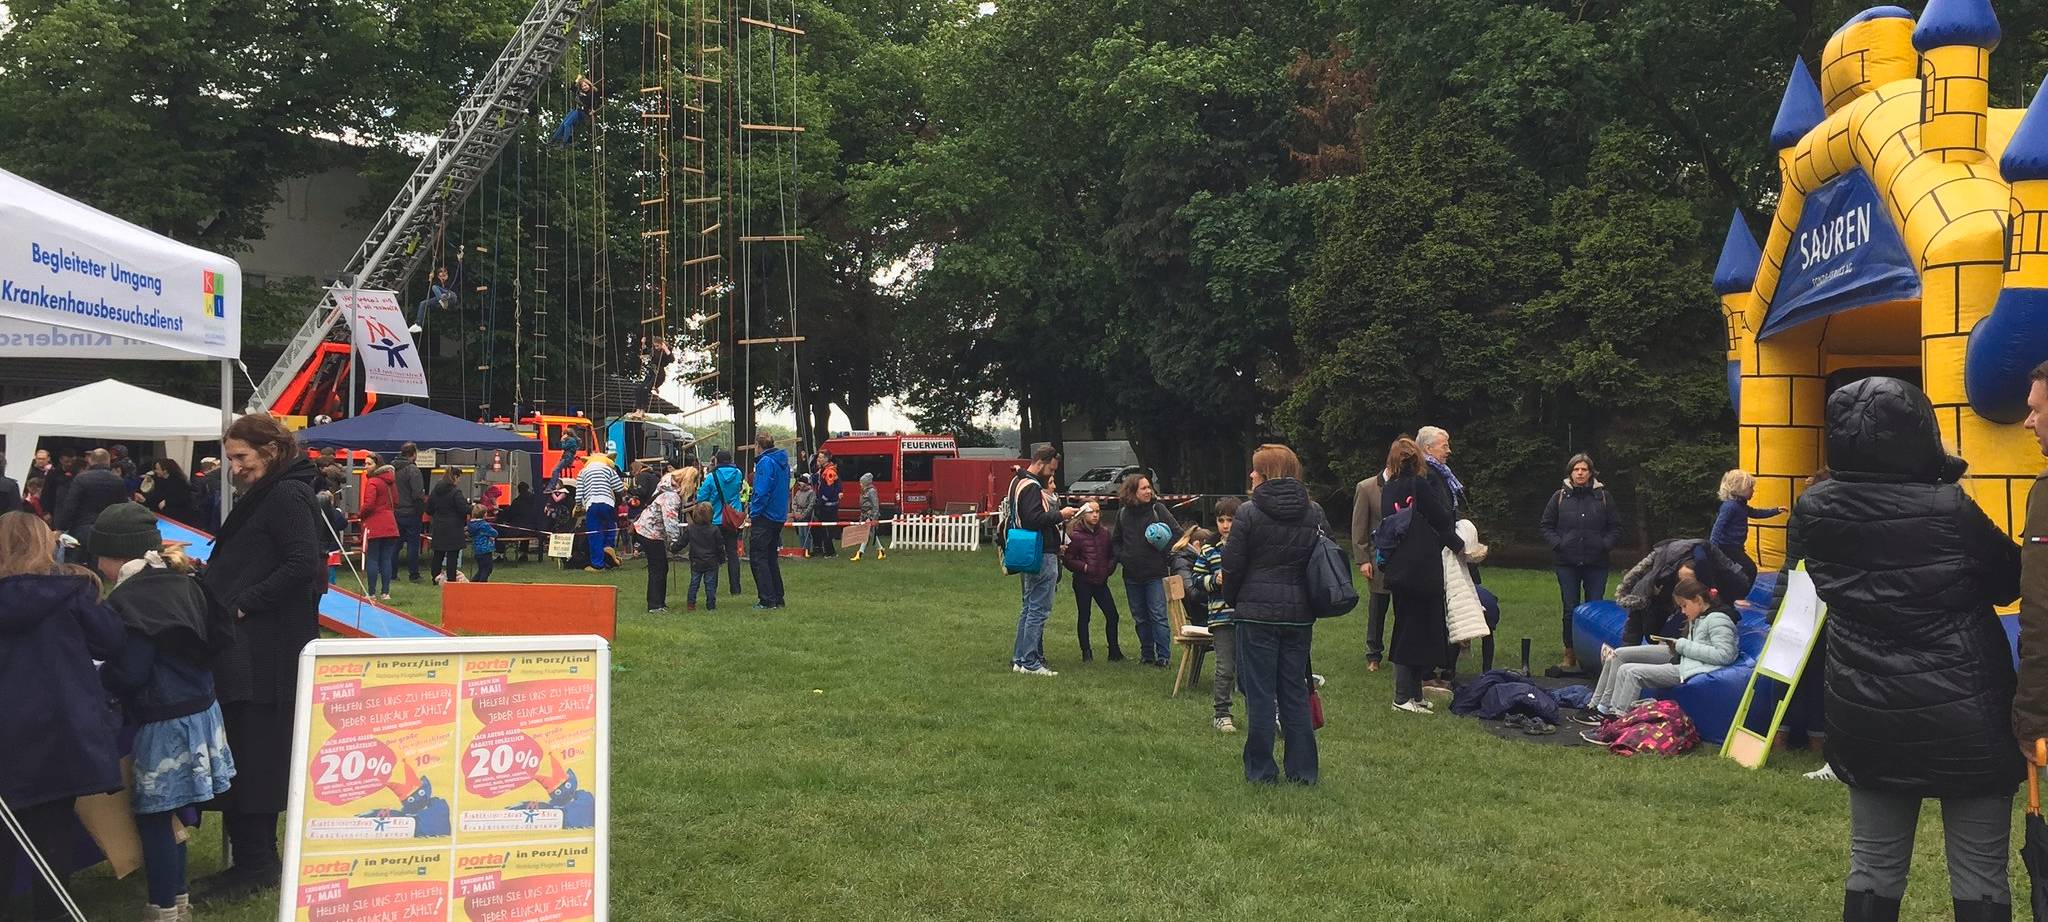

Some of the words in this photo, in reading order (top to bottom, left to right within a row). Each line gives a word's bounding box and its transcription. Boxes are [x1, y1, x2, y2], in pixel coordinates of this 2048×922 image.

[1800, 202, 1871, 270] SAUREN
[31, 241, 107, 278] Begleiteter
[110, 261, 162, 296] Umgang
[1, 278, 184, 332] Krankenhausbesuchsdienst
[901, 441, 955, 449] FEUERWEHR
[376, 660, 389, 669] in
[392, 659, 449, 669] Porz/Lind
[521, 656, 533, 665] in
[536, 655, 590, 664] Porz/Lind
[331, 701, 362, 714] HELFEN
[365, 698, 381, 709] SIE
[383, 696, 401, 706] UNS
[403, 693, 418, 703] ZU
[479, 695, 509, 709] HELFEN
[512, 693, 527, 703] SIE
[529, 690, 547, 700] UNS
[549, 687, 562, 697] ZU
[340, 715, 367, 729] JEDER
[487, 710, 513, 724] JEDER
[316, 750, 392, 785] 20%
[467, 744, 539, 778] 20%
[364, 857, 377, 866] in
[380, 854, 440, 865] Porz/Lind
[516, 850, 528, 859] in
[531, 847, 588, 858] Porz/Lind
[316, 904, 349, 917] HELFEN
[352, 900, 369, 911] SIE
[371, 896, 391, 907] UNS
[393, 892, 408, 903] ZU
[471, 895, 503, 909] HELFEN
[506, 892, 521, 902] SIE
[523, 887, 543, 899] UNS
[545, 884, 559, 895] ZU
